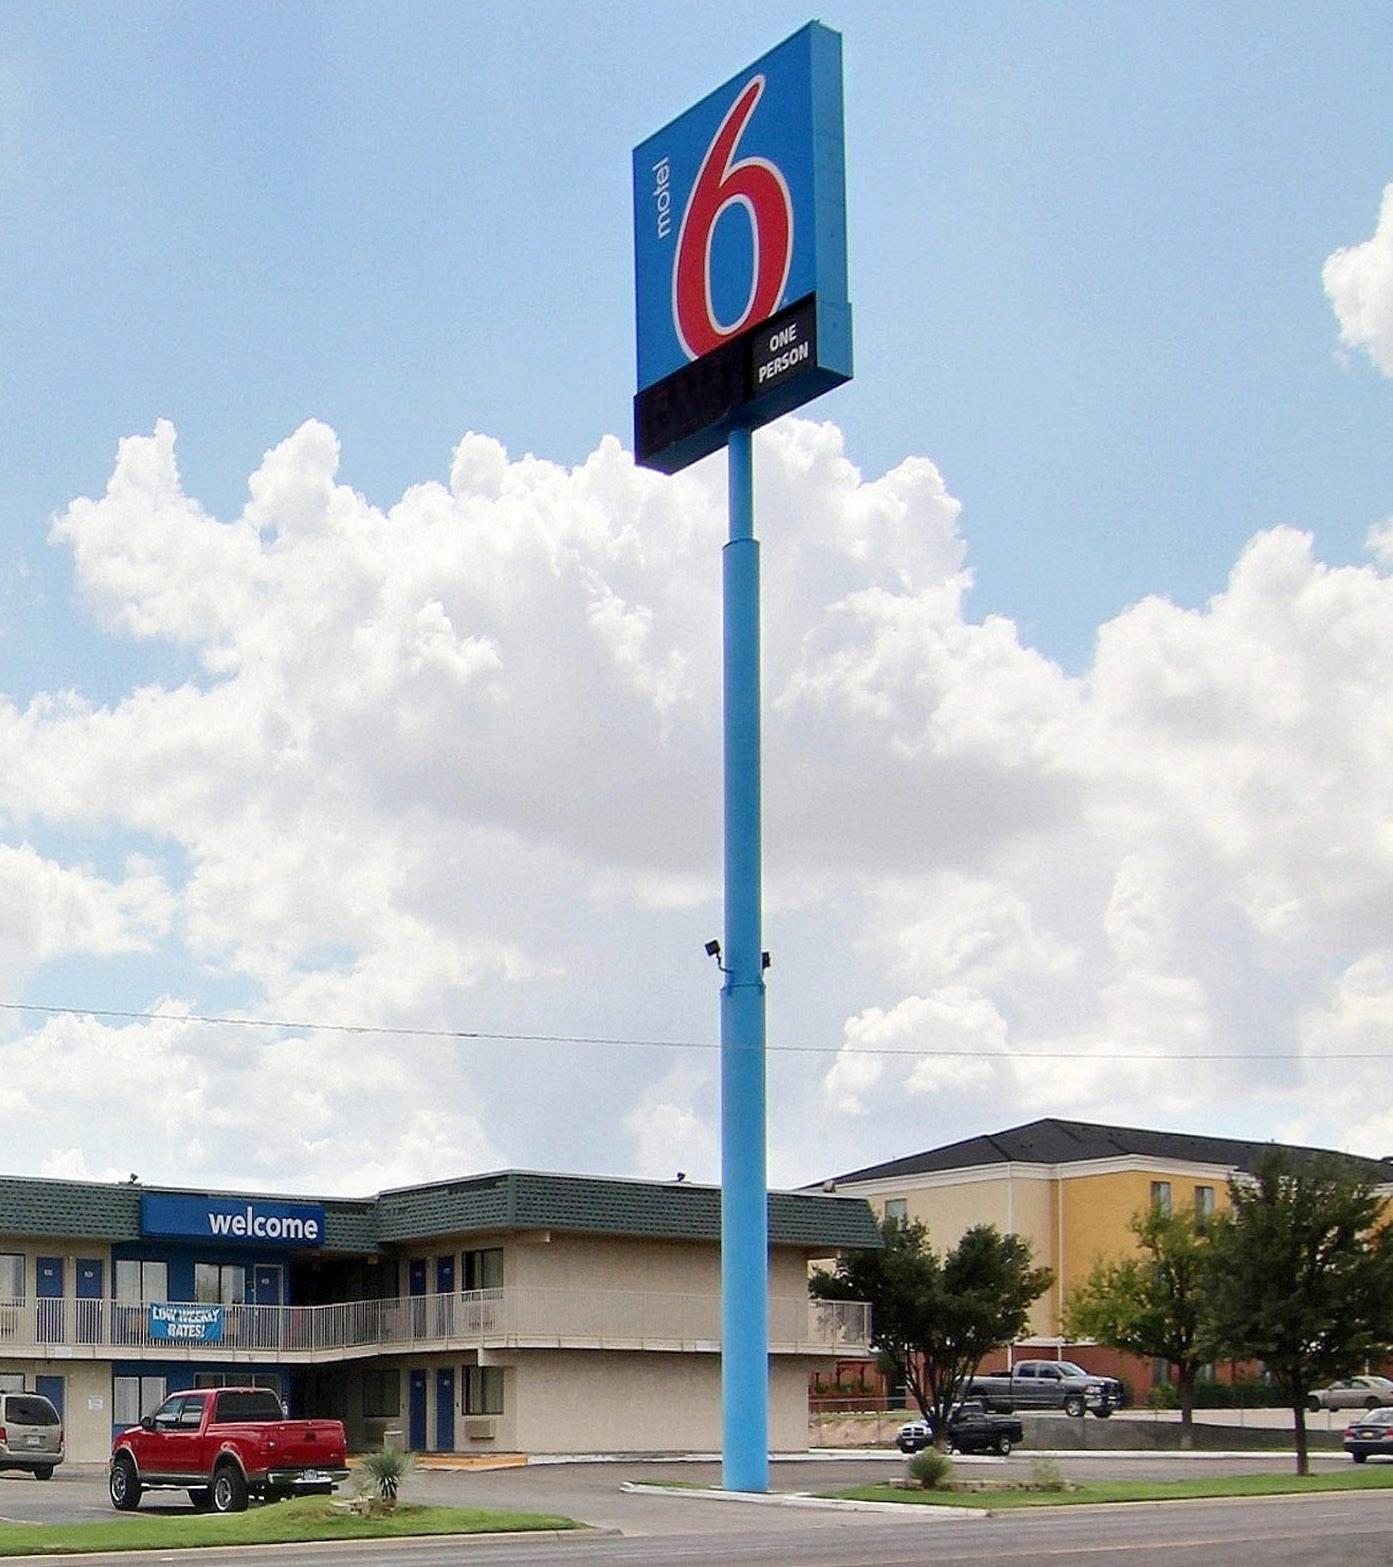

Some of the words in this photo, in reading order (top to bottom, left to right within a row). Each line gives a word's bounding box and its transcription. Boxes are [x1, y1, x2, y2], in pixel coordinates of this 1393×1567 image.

[652, 157, 671, 239] motel
[672, 74, 794, 362] 6
[769, 323, 797, 352] ONE
[758, 341, 808, 383] PERSON
[208, 1206, 318, 1239] welcome
[152, 1306, 177, 1322] LOW
[168, 1323, 206, 1338] RATES!
